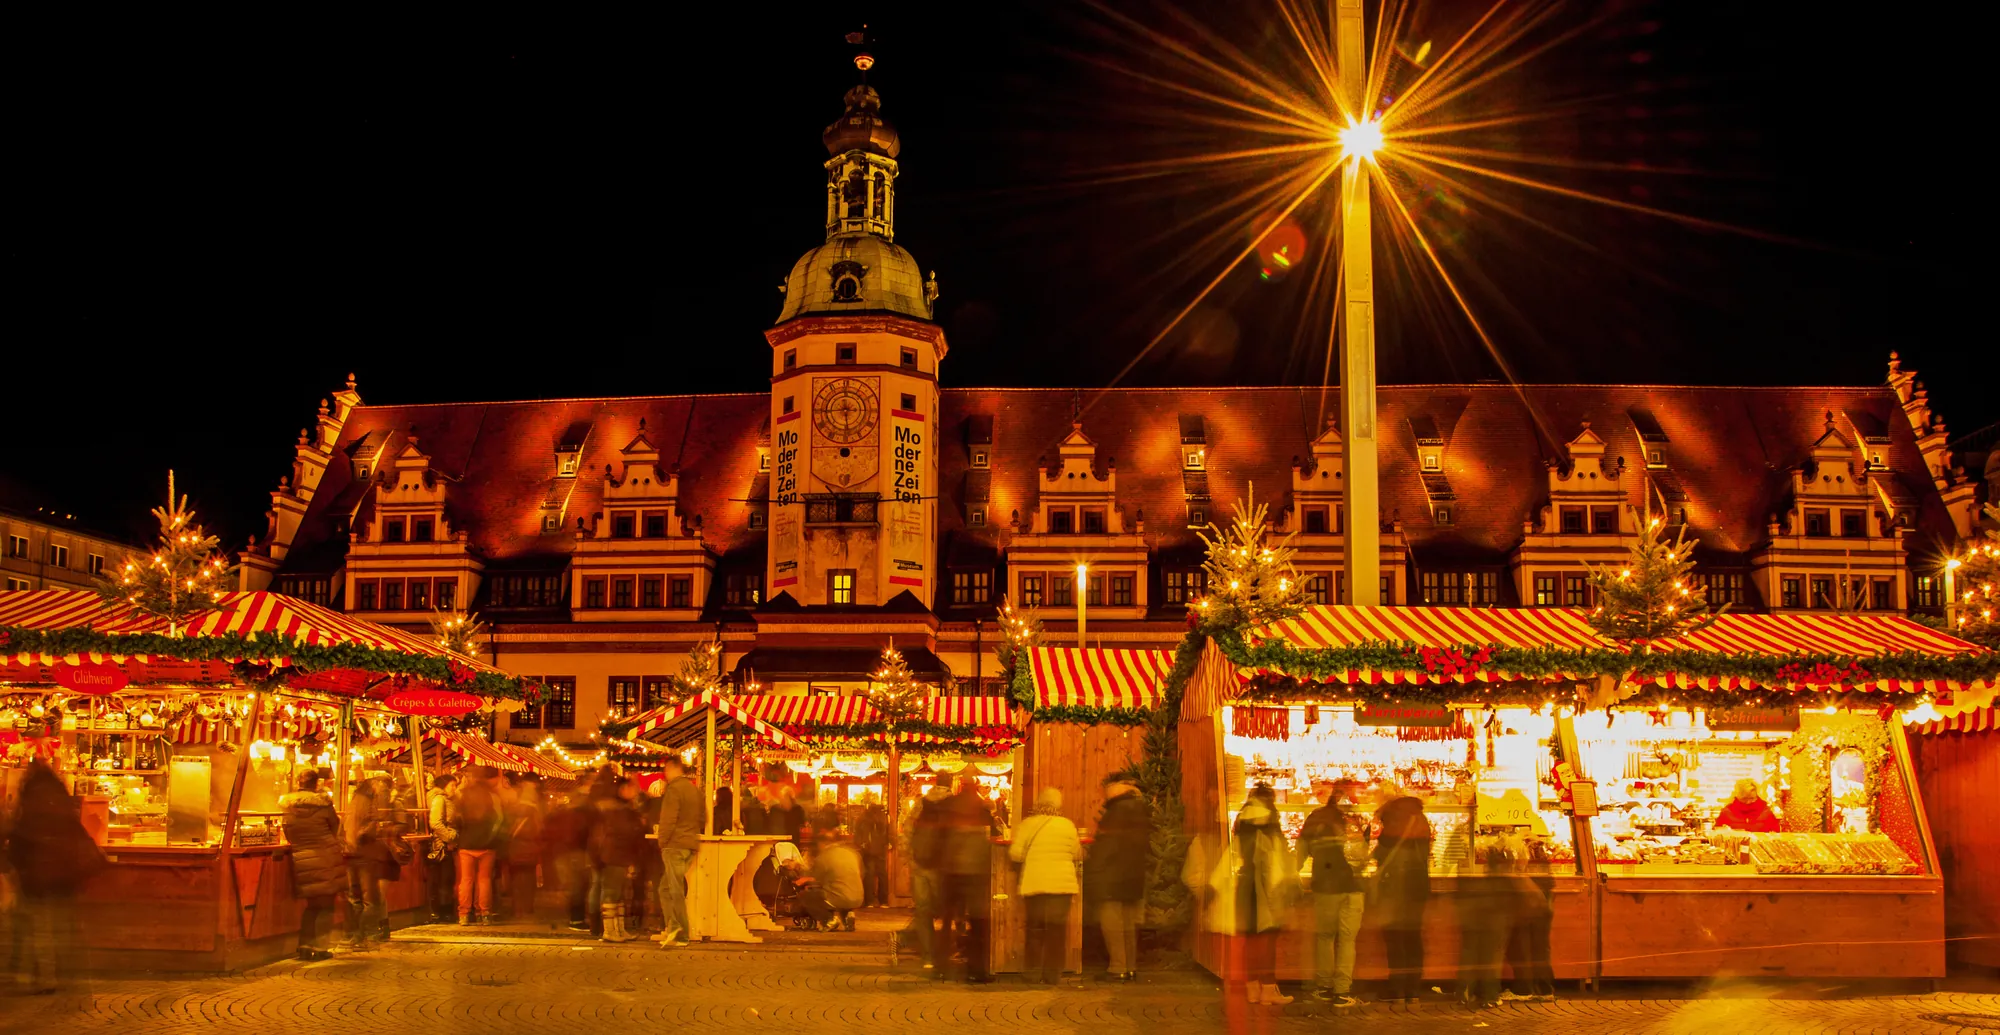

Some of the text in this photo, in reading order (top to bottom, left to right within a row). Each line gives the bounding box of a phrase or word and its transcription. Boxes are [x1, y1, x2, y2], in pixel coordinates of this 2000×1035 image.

[778, 430, 798, 448] Mo
[895, 425, 921, 445] Mo
[778, 448, 798, 463] der
[894, 443, 921, 461] der
[778, 463, 793, 476] ne
[894, 459, 915, 473] ne
[777, 474, 796, 493] Zei
[894, 471, 919, 490] Zei
[777, 491, 797, 507] ten
[894, 488, 921, 505] ten
[73, 669, 113, 686] Glühwein
[393, 696, 477, 710] Crêpes & Galettes
[1721, 710, 1784, 724] Schinken
[1508, 809, 1519, 819] 10
